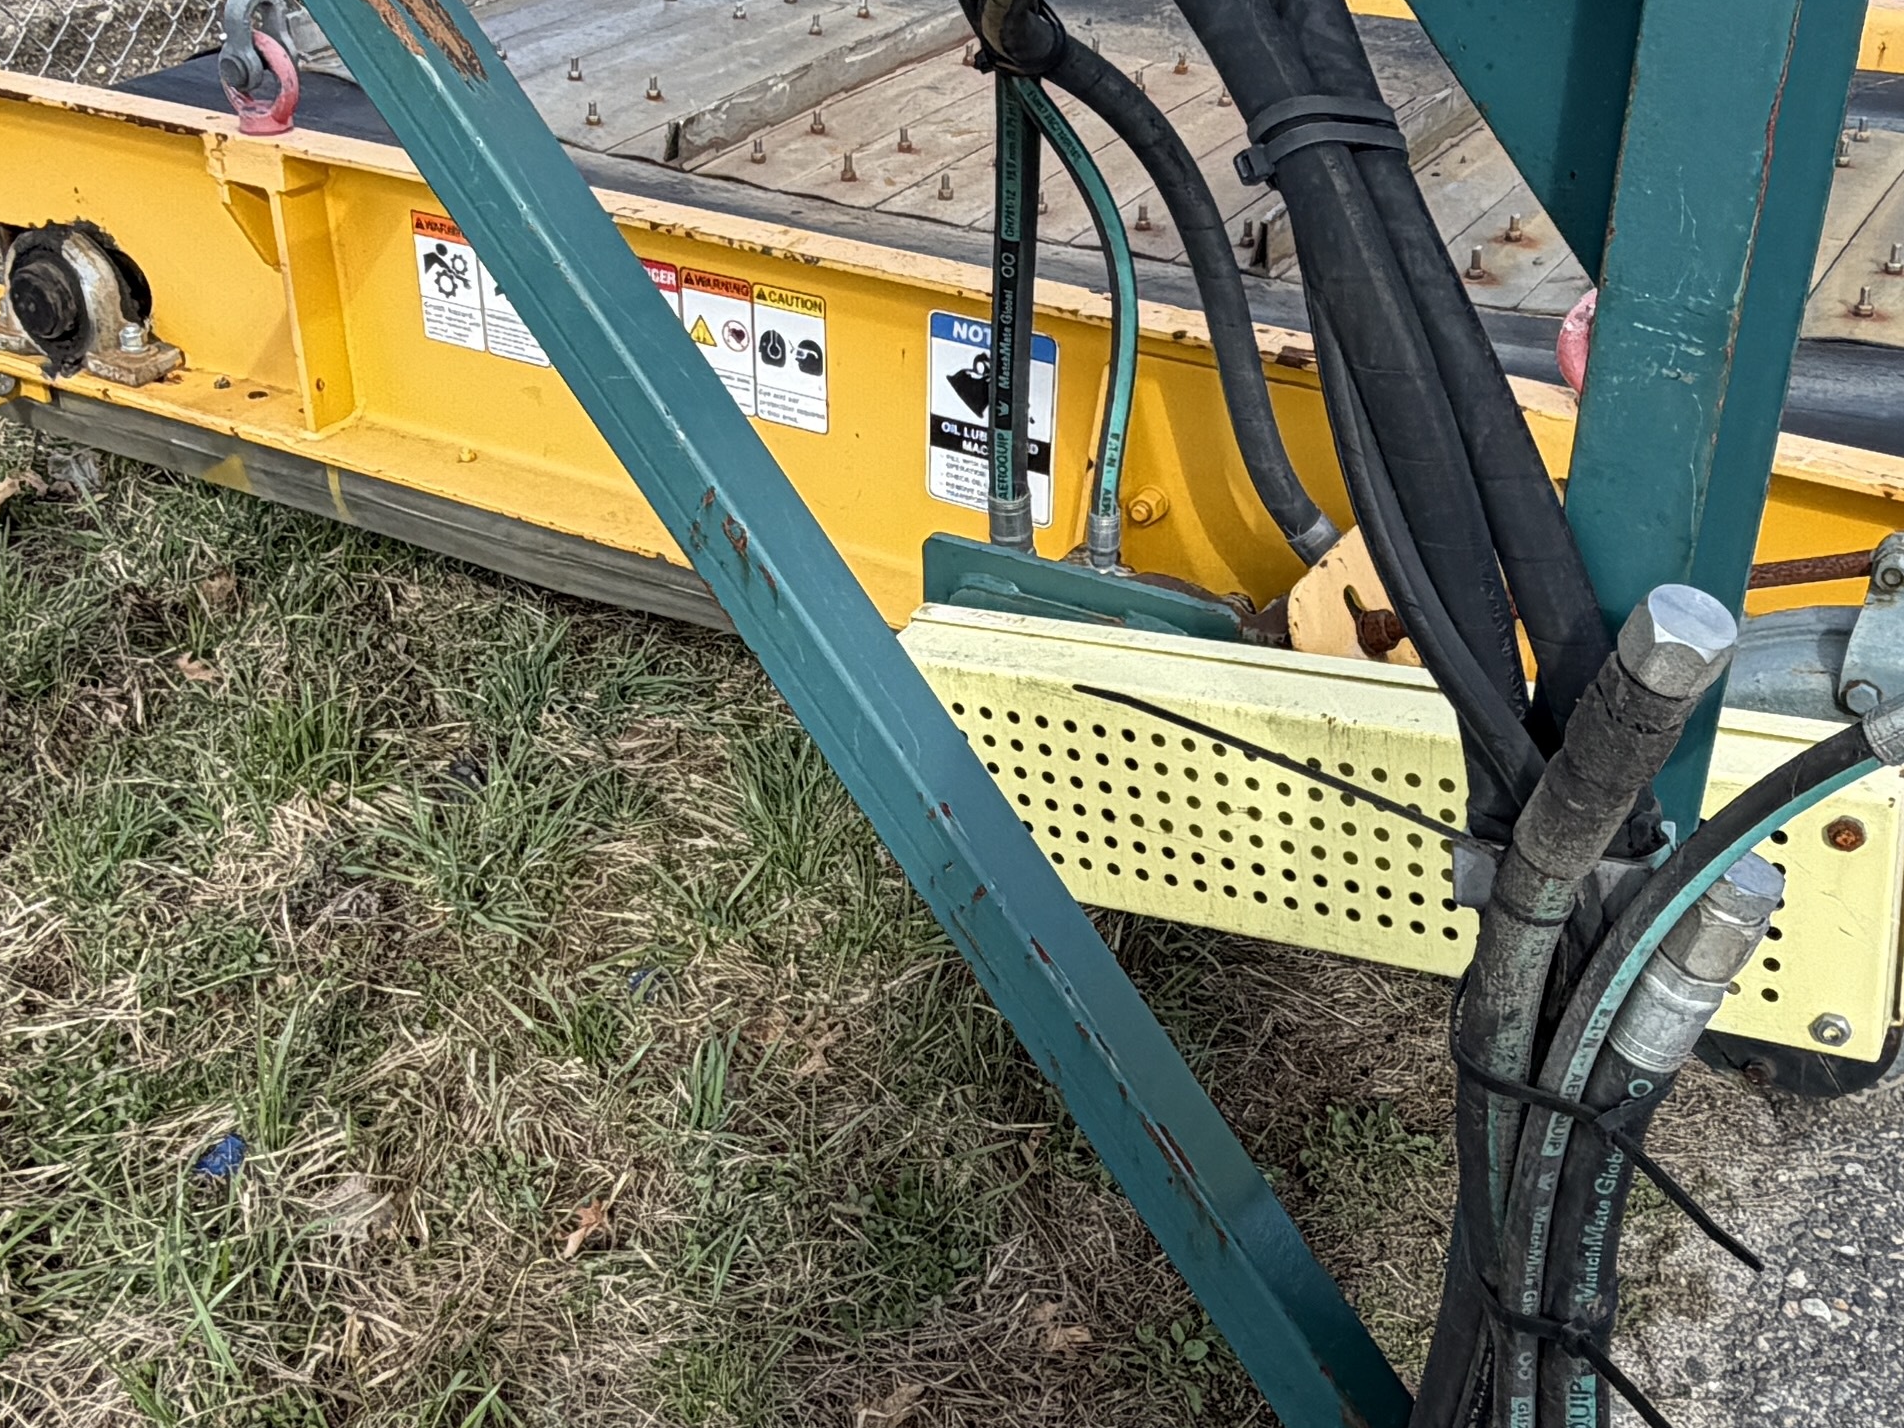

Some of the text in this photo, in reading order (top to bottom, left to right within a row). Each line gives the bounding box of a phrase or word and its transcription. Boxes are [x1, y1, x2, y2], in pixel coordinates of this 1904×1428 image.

[695, 274, 749, 297] WARNING
[768, 290, 823, 314] CAUTION
[1000, 291, 1014, 325] Global
[953, 321, 991, 346] NOT
[995, 433, 1010, 501] AEROQUIP
[1594, 1148, 1625, 1196] Glob
[1522, 1292, 1539, 1316] Glo
